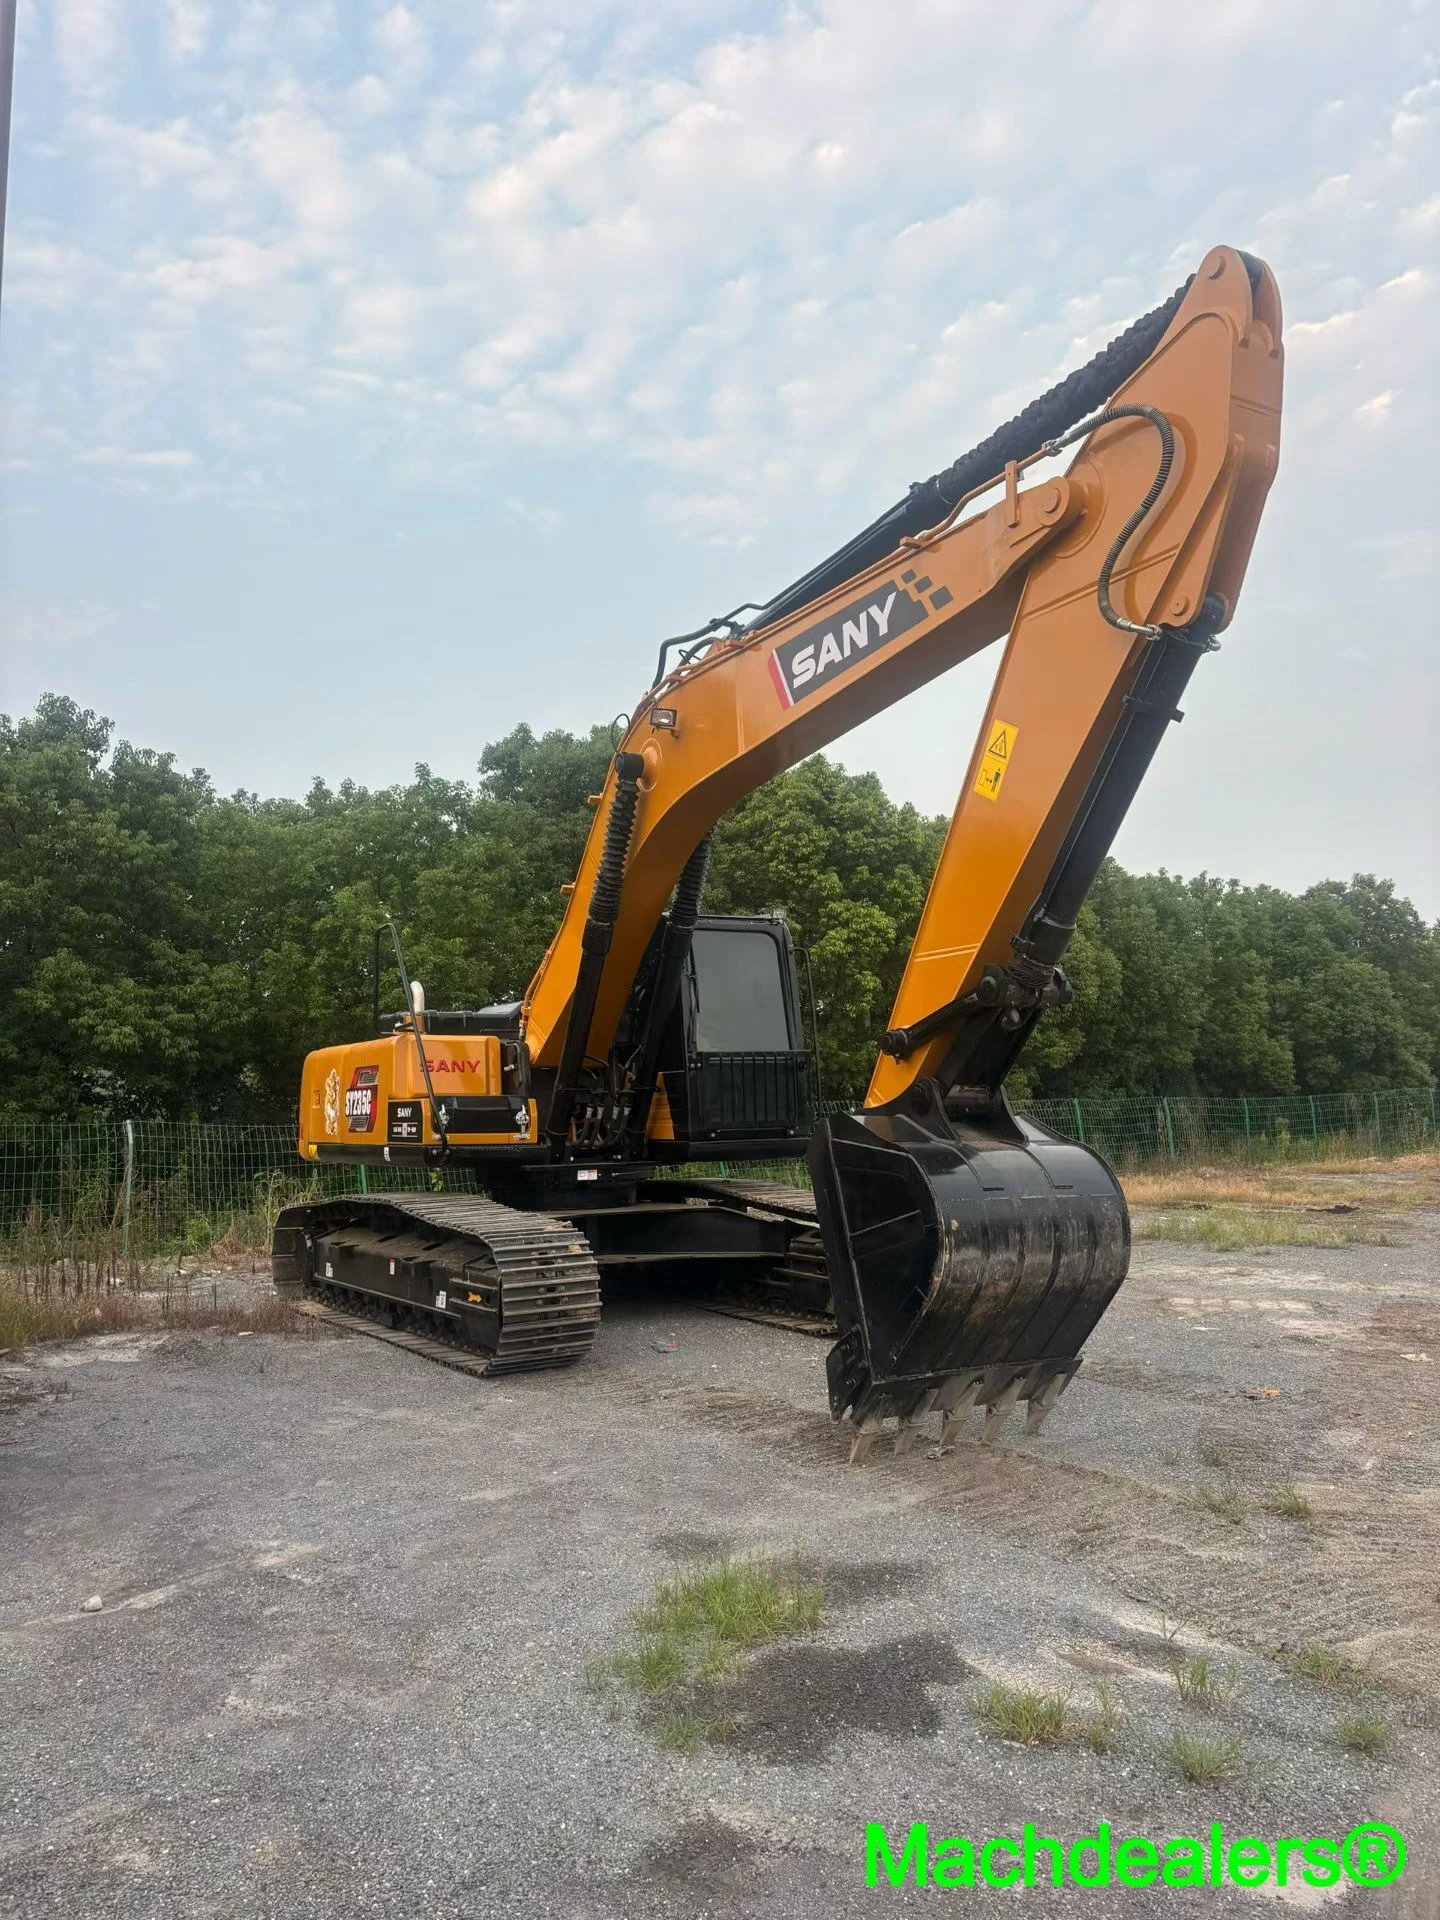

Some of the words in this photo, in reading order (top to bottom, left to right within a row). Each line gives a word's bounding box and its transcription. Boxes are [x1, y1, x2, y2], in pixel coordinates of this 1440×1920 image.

[791, 591, 897, 689] SANY
[420, 1060, 480, 1073] SANY
[397, 1107, 412, 1118] SANY
